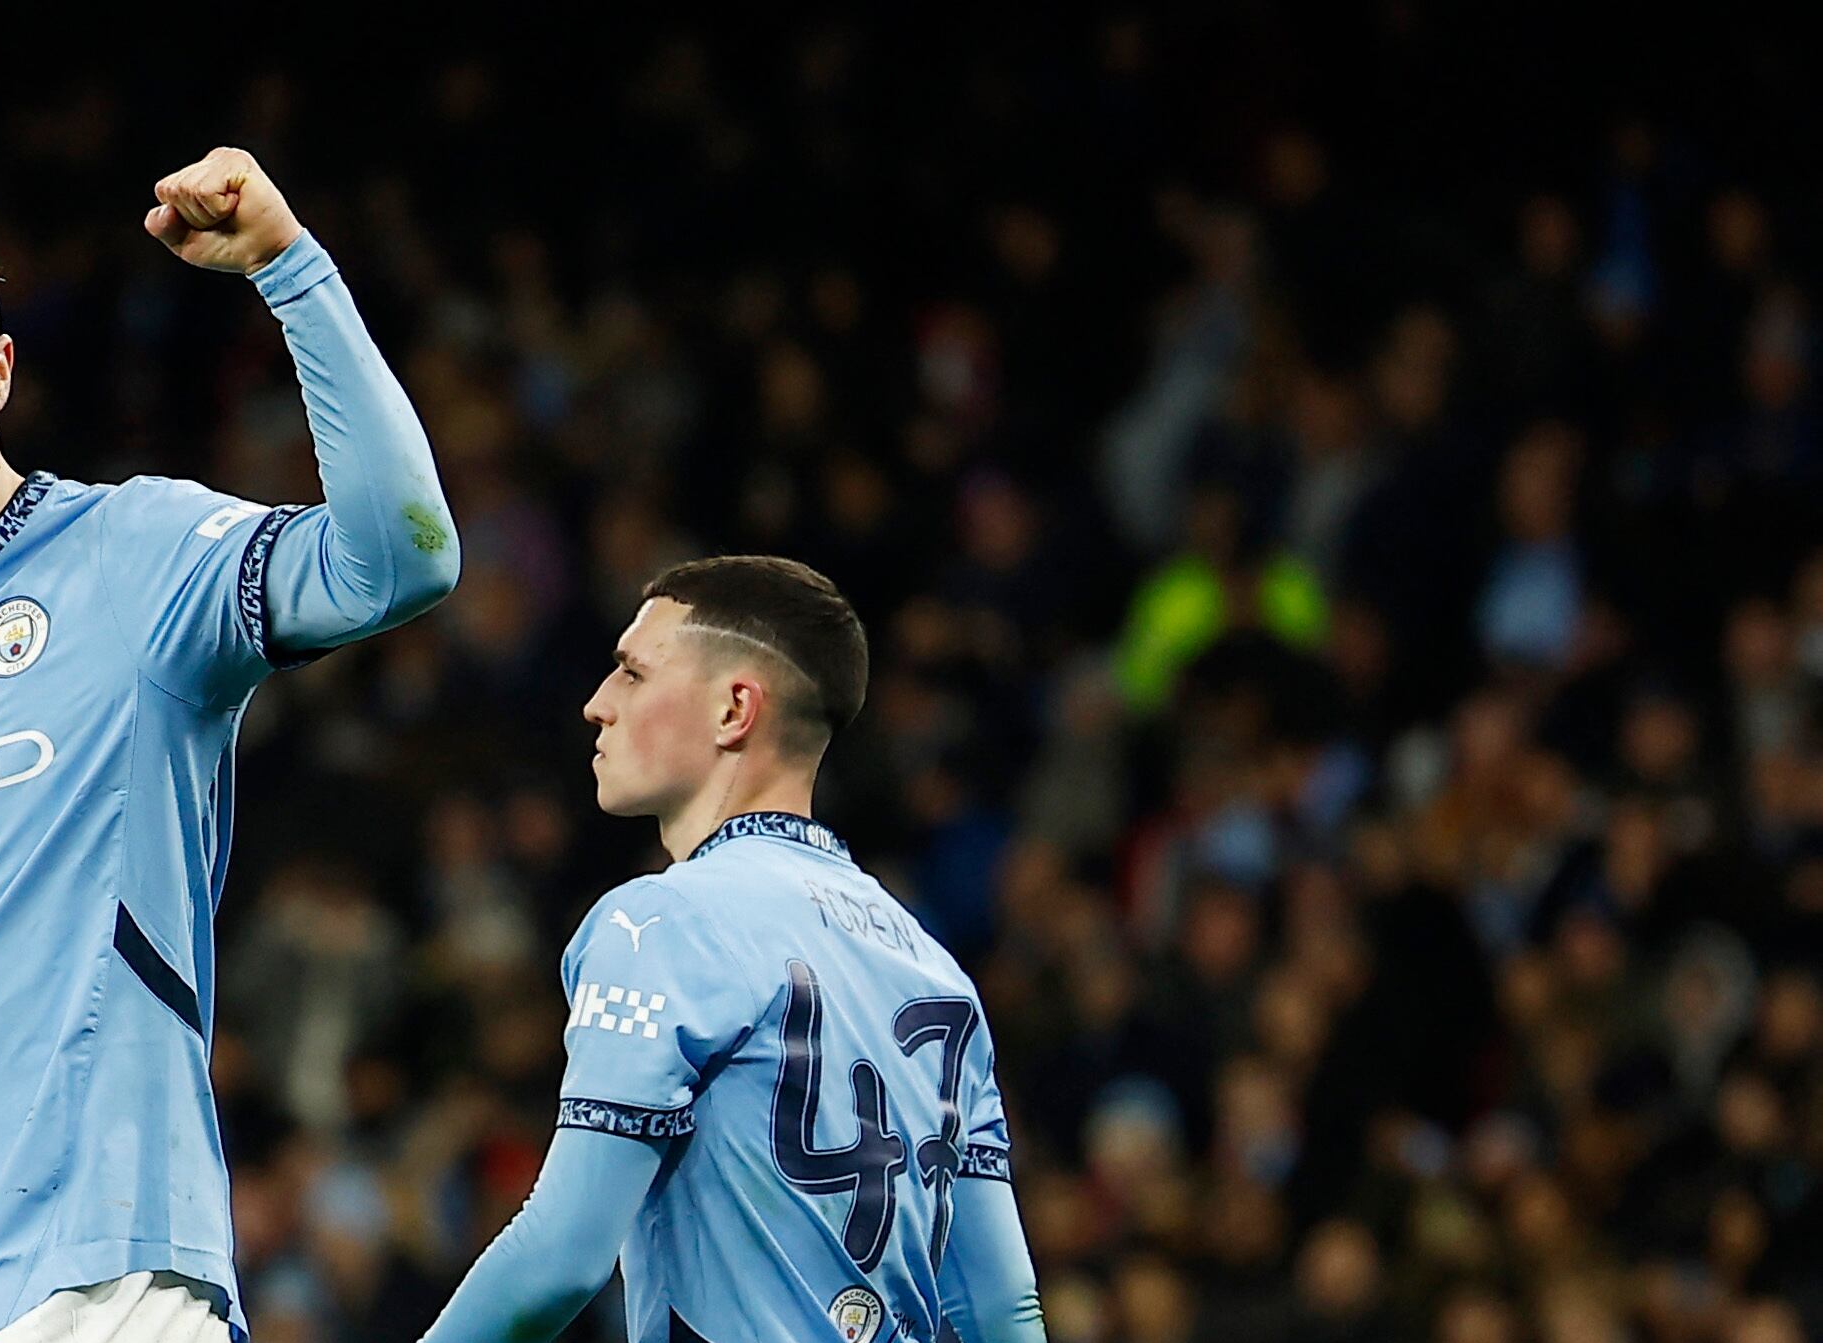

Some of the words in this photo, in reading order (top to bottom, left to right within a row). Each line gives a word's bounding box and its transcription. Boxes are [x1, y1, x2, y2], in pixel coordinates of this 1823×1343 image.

[6, 661, 27, 674] CITY
[769, 957, 980, 1276] 47
[834, 1290, 879, 1315] MANCHESTER
